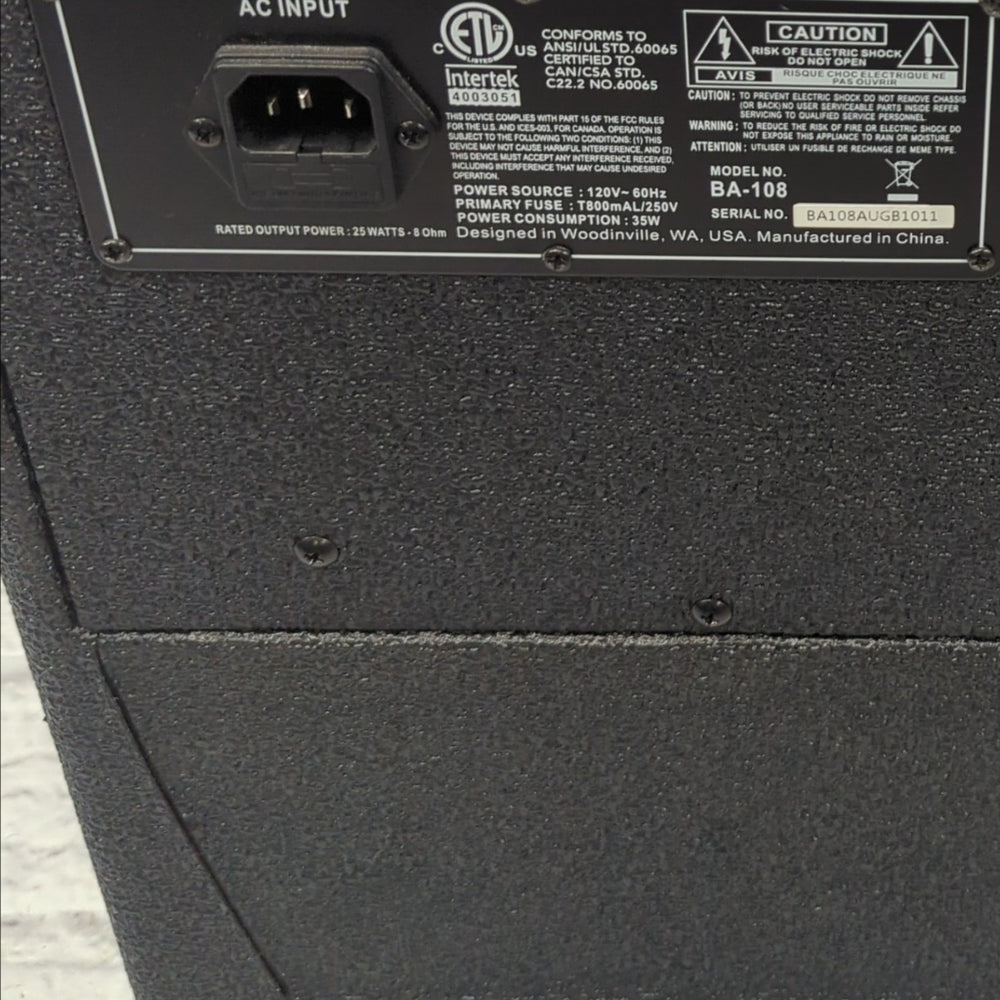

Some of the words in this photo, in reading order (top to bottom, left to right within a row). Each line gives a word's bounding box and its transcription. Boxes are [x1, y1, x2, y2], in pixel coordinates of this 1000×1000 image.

[541, 29, 622, 41] CONFORMS
[626, 31, 646, 41] TO
[778, 25, 877, 41] CAUTION
[514, 45, 537, 56] US
[751, 46, 778, 56] RISK
[781, 47, 797, 56] OF
[800, 47, 857, 57] ELECTRIC
[860, 49, 901, 58] SHOCK
[544, 55, 611, 65] CERTIFIED
[615, 56, 634, 65] TO
[787, 57, 804, 66] DO
[807, 57, 831, 66] NOT
[833, 58, 866, 67] OPEN
[445, 68, 520, 88] Intertek
[545, 67, 610, 78] CAN/CSA
[614, 68, 644, 78] STD.
[715, 70, 756, 81] AVIS
[783, 69, 823, 78] RISQUE
[827, 70, 857, 78] CHOC
[860, 70, 928, 79] ELECTRIQUE
[931, 71, 945, 79] NE
[546, 79, 584, 89] C22.2
[589, 80, 657, 90] NO.60065
[855, 78, 896, 86] OUVRIR
[452, 91, 517, 103] 4003051
[739, 91, 750, 100] TO
[753, 92, 789, 100] PREVENT
[792, 92, 830, 101] ELECTRIC
[833, 93, 860, 102] SHOCK
[863, 93, 875, 102] DO
[878, 94, 894, 102] NOT
[897, 94, 929, 103] REMOVE
[932, 94, 966, 103] CHASSIS
[796, 102, 818, 110] USER
[821, 102, 873, 111] SERVICEABLE
[876, 103, 901, 112] PARTS
[904, 103, 929, 112] INSIDE
[932, 104, 958, 112] REFER
[445, 113, 463, 121] THIS
[464, 113, 493, 121] DEVICE
[495, 114, 535, 122] COMPLIES
[536, 114, 557, 122] WITH
[558, 114, 578, 123] PART
[581, 115, 589, 123] 15
[590, 115, 601, 123] OF
[603, 115, 618, 123] THE
[620, 116, 636, 124] FCC
[638, 116, 664, 124] RULES
[740, 111, 782, 120] SERVICING
[785, 111, 795, 120] TO
[798, 112, 839, 120] QUALIFIED
[842, 112, 875, 121] SERVICE
[446, 123, 463, 131] FOR
[465, 123, 480, 131] THE
[607, 126, 652, 134] OPERATION
[654, 126, 661, 134] IS
[743, 122, 753, 130] TO
[756, 122, 788, 131] REDUCE
[791, 123, 806, 131] THE
[809, 123, 828, 131] RISK
[830, 123, 841, 132] OF
[844, 123, 862, 132] FIRE
[865, 124, 876, 132] OR
[879, 124, 917, 132] ELECTRIC
[920, 124, 946, 133] SHOCK
[949, 125, 961, 133] DO
[742, 132, 758, 140] NOT
[762, 132, 792, 140] EXPOSE
[816, 133, 858, 141] APPLIANCE
[862, 133, 872, 141] TO
[874, 133, 893, 141] RAIN
[896, 133, 908, 142] OR
[750, 143, 785, 152] UTILISER
[788, 144, 799, 152] UN
[802, 144, 834, 152] FUSIBLE
[850, 145, 892, 153] RECHANGE
[896, 145, 906, 153] DE
[909, 146, 931, 154] MEME
[935, 146, 956, 154] TYPE.
[453, 172, 499, 180] OPERATION.
[710, 165, 758, 177] MODEL
[762, 166, 786, 177] NO.
[453, 185, 507, 197] POWER
[511, 186, 572, 197] SOURCE
[632, 187, 666, 198] 60Hz
[710, 181, 788, 198] BA-108
[455, 199, 520, 210] PRIMARY
[524, 200, 562, 211] FUSE
[577, 200, 677, 212] T800mAL/250V
[711, 208, 760, 219] SERIAL
[764, 209, 788, 219] NO.
[806, 210, 938, 222] BA108AUGB1011
[457, 213, 510, 224] POWER
[514, 214, 620, 225] CONSUMPTION
[632, 215, 660, 226] 35W
[215, 225, 253, 235] RATED
[255, 225, 299, 235] OUTPUT
[302, 226, 344, 236] POWER
[352, 226, 365, 236] 25
[367, 227, 404, 237] WATTS
[413, 227, 419, 237] 8
[422, 228, 446, 237] Ohm
[456, 226, 536, 241] Designed
[541, 228, 556, 240] in
[560, 228, 664, 242] Woodinville,
[670, 229, 703, 243] WA,
[709, 229, 751, 242] USA.
[757, 230, 871, 243] Manufactured
[877, 231, 890, 242] in
[896, 231, 950, 244] China.
